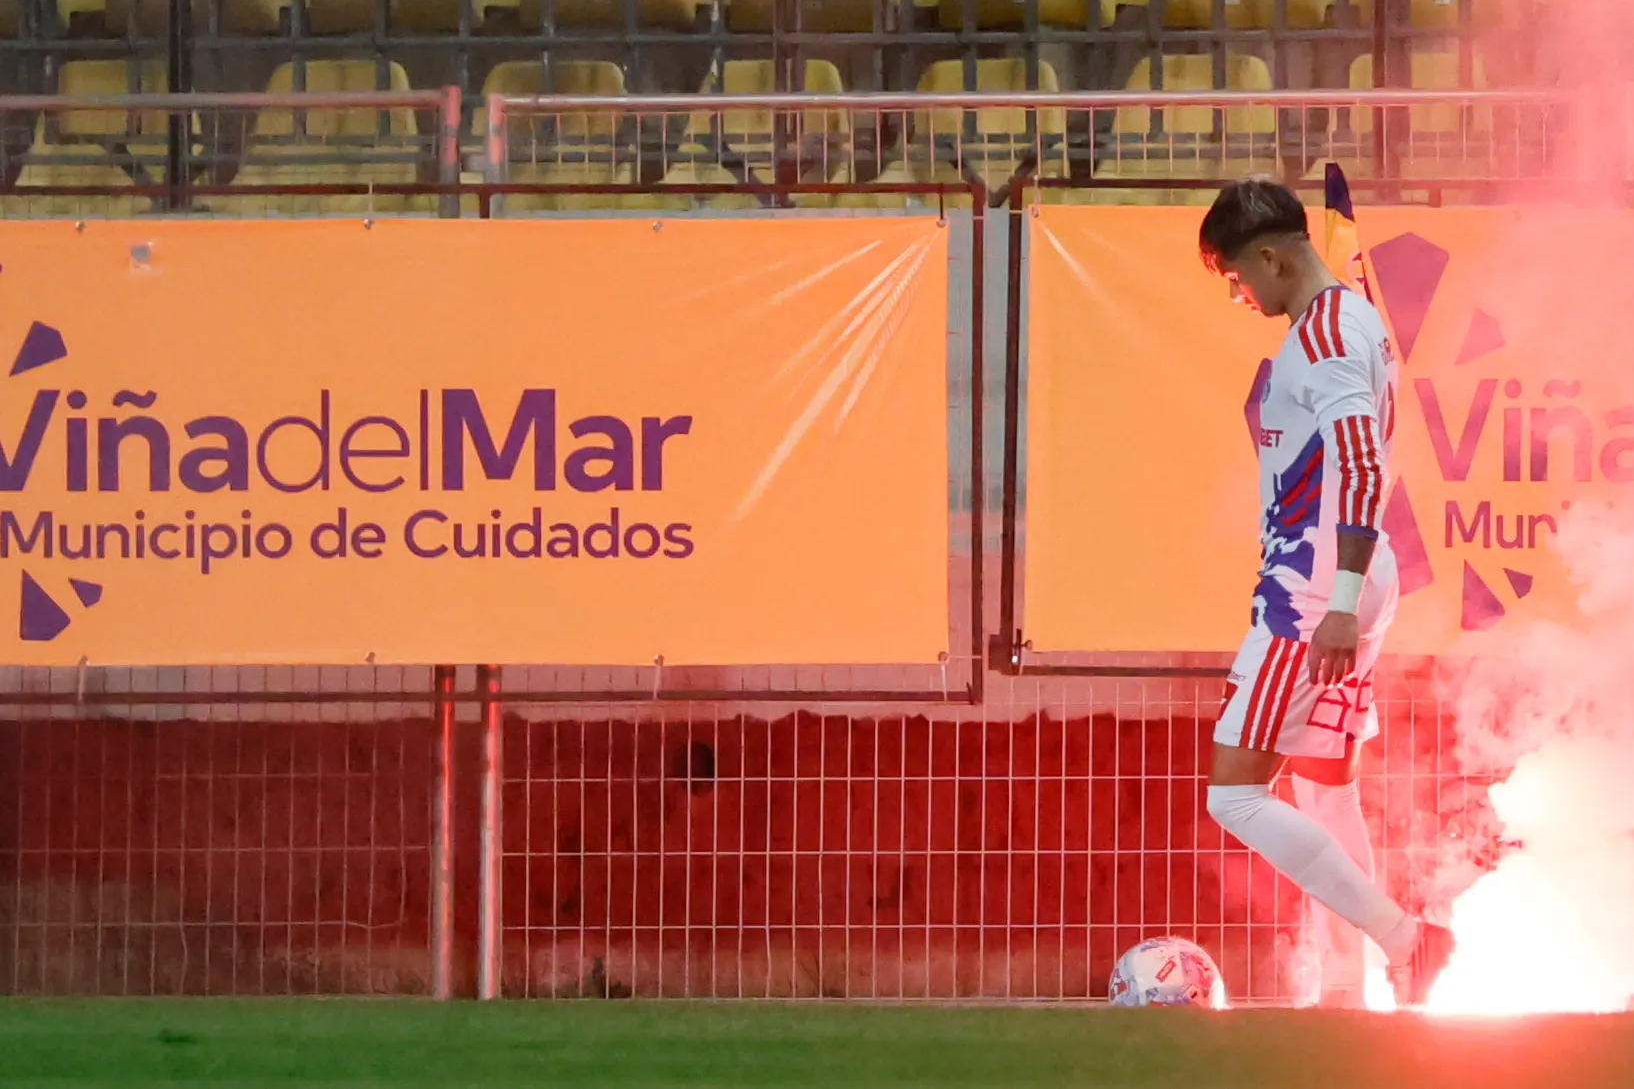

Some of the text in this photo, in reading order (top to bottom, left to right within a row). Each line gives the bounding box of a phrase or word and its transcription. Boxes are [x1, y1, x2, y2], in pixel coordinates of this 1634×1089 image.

[0, 508, 695, 574] Municipio de Cuidados
